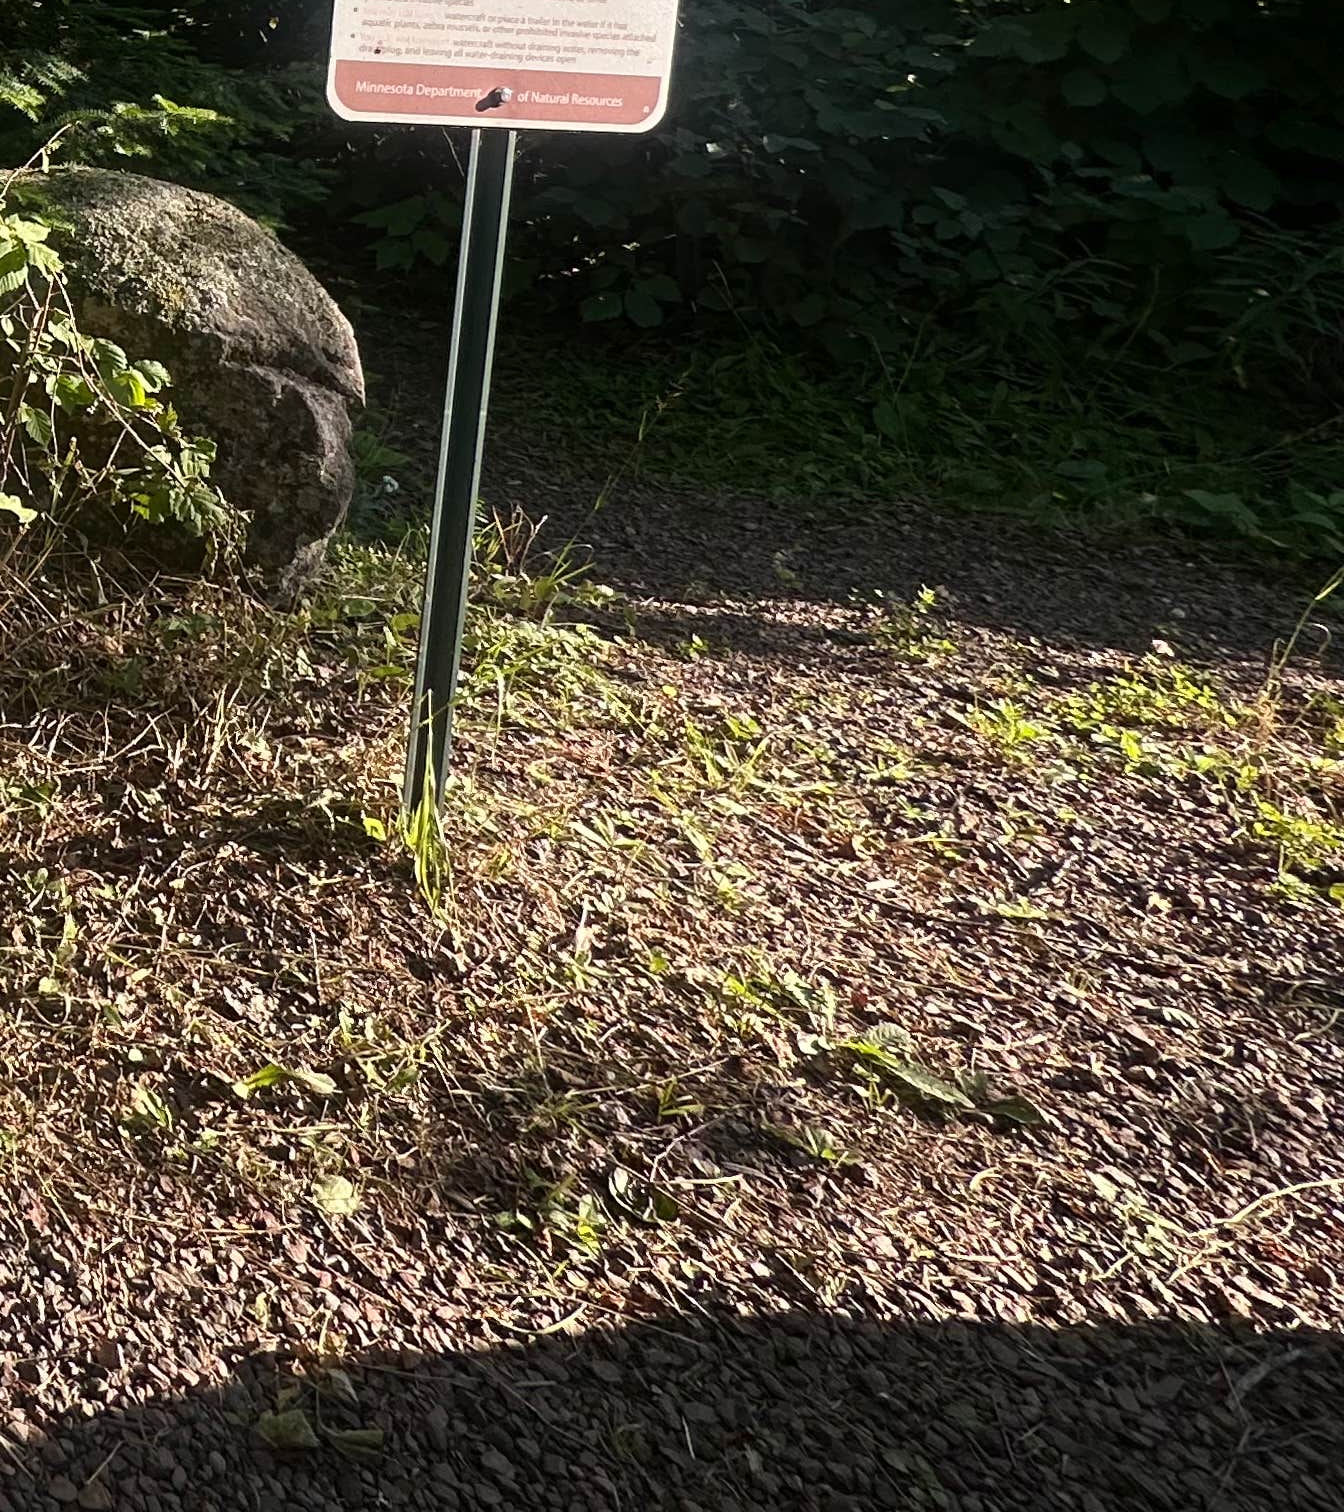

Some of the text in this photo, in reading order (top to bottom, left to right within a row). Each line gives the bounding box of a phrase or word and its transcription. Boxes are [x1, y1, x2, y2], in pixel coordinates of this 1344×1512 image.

[355, 80, 623, 107] Minnesota Department of Natural Resources
